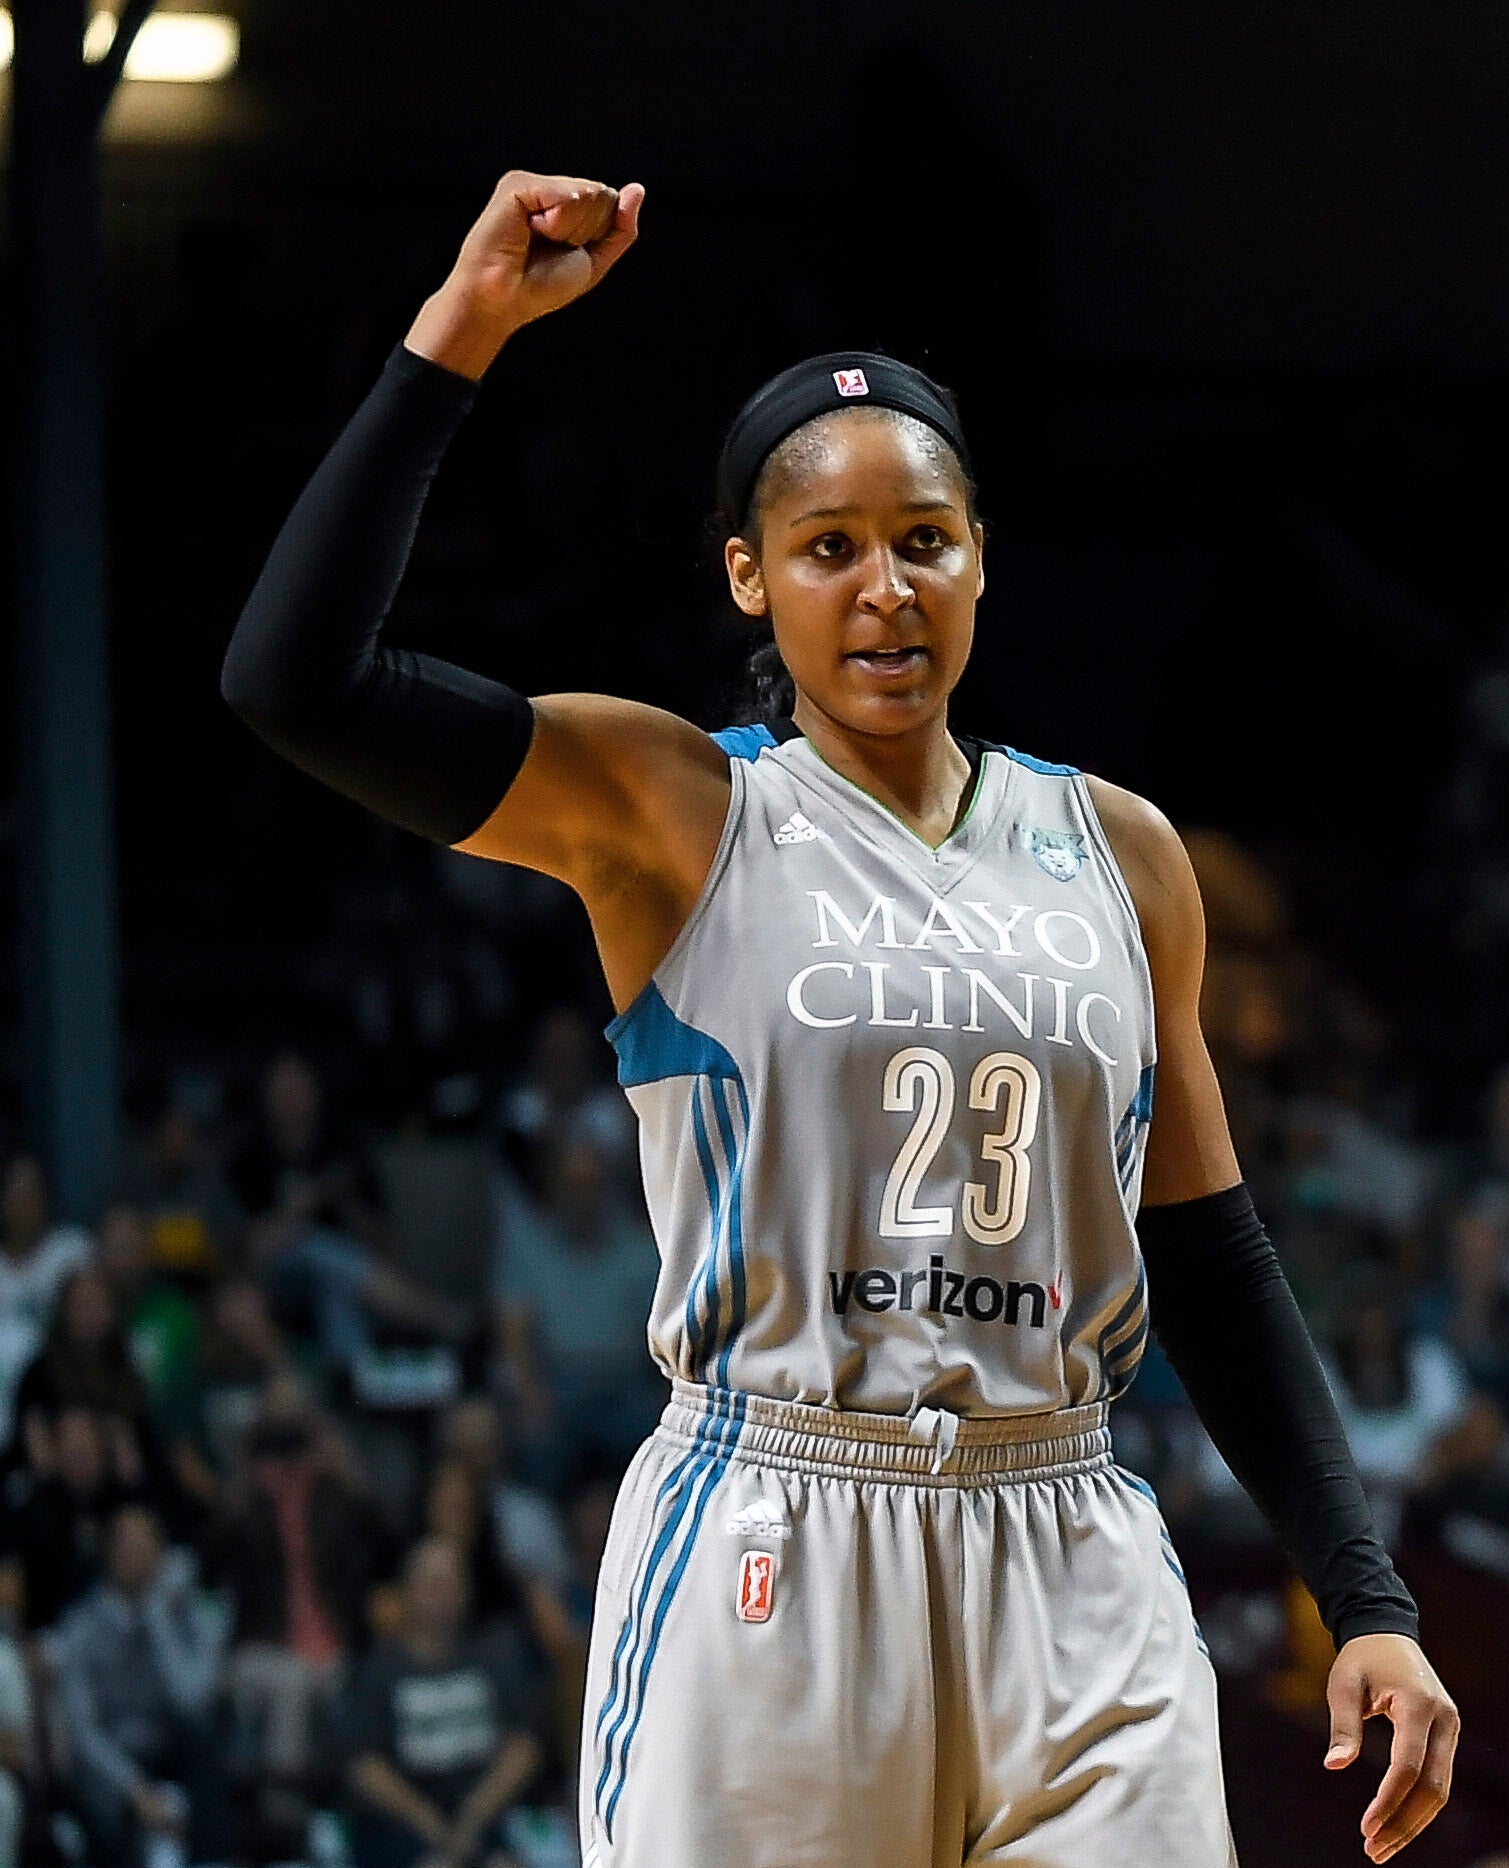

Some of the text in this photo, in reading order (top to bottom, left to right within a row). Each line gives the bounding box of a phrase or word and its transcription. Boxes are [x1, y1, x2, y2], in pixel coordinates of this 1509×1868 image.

[805, 889, 1102, 971] MAYO
[786, 961, 1122, 1067] CLINIC
[878, 1045, 1042, 1246] 23
[828, 1253, 1046, 1328] verizon
